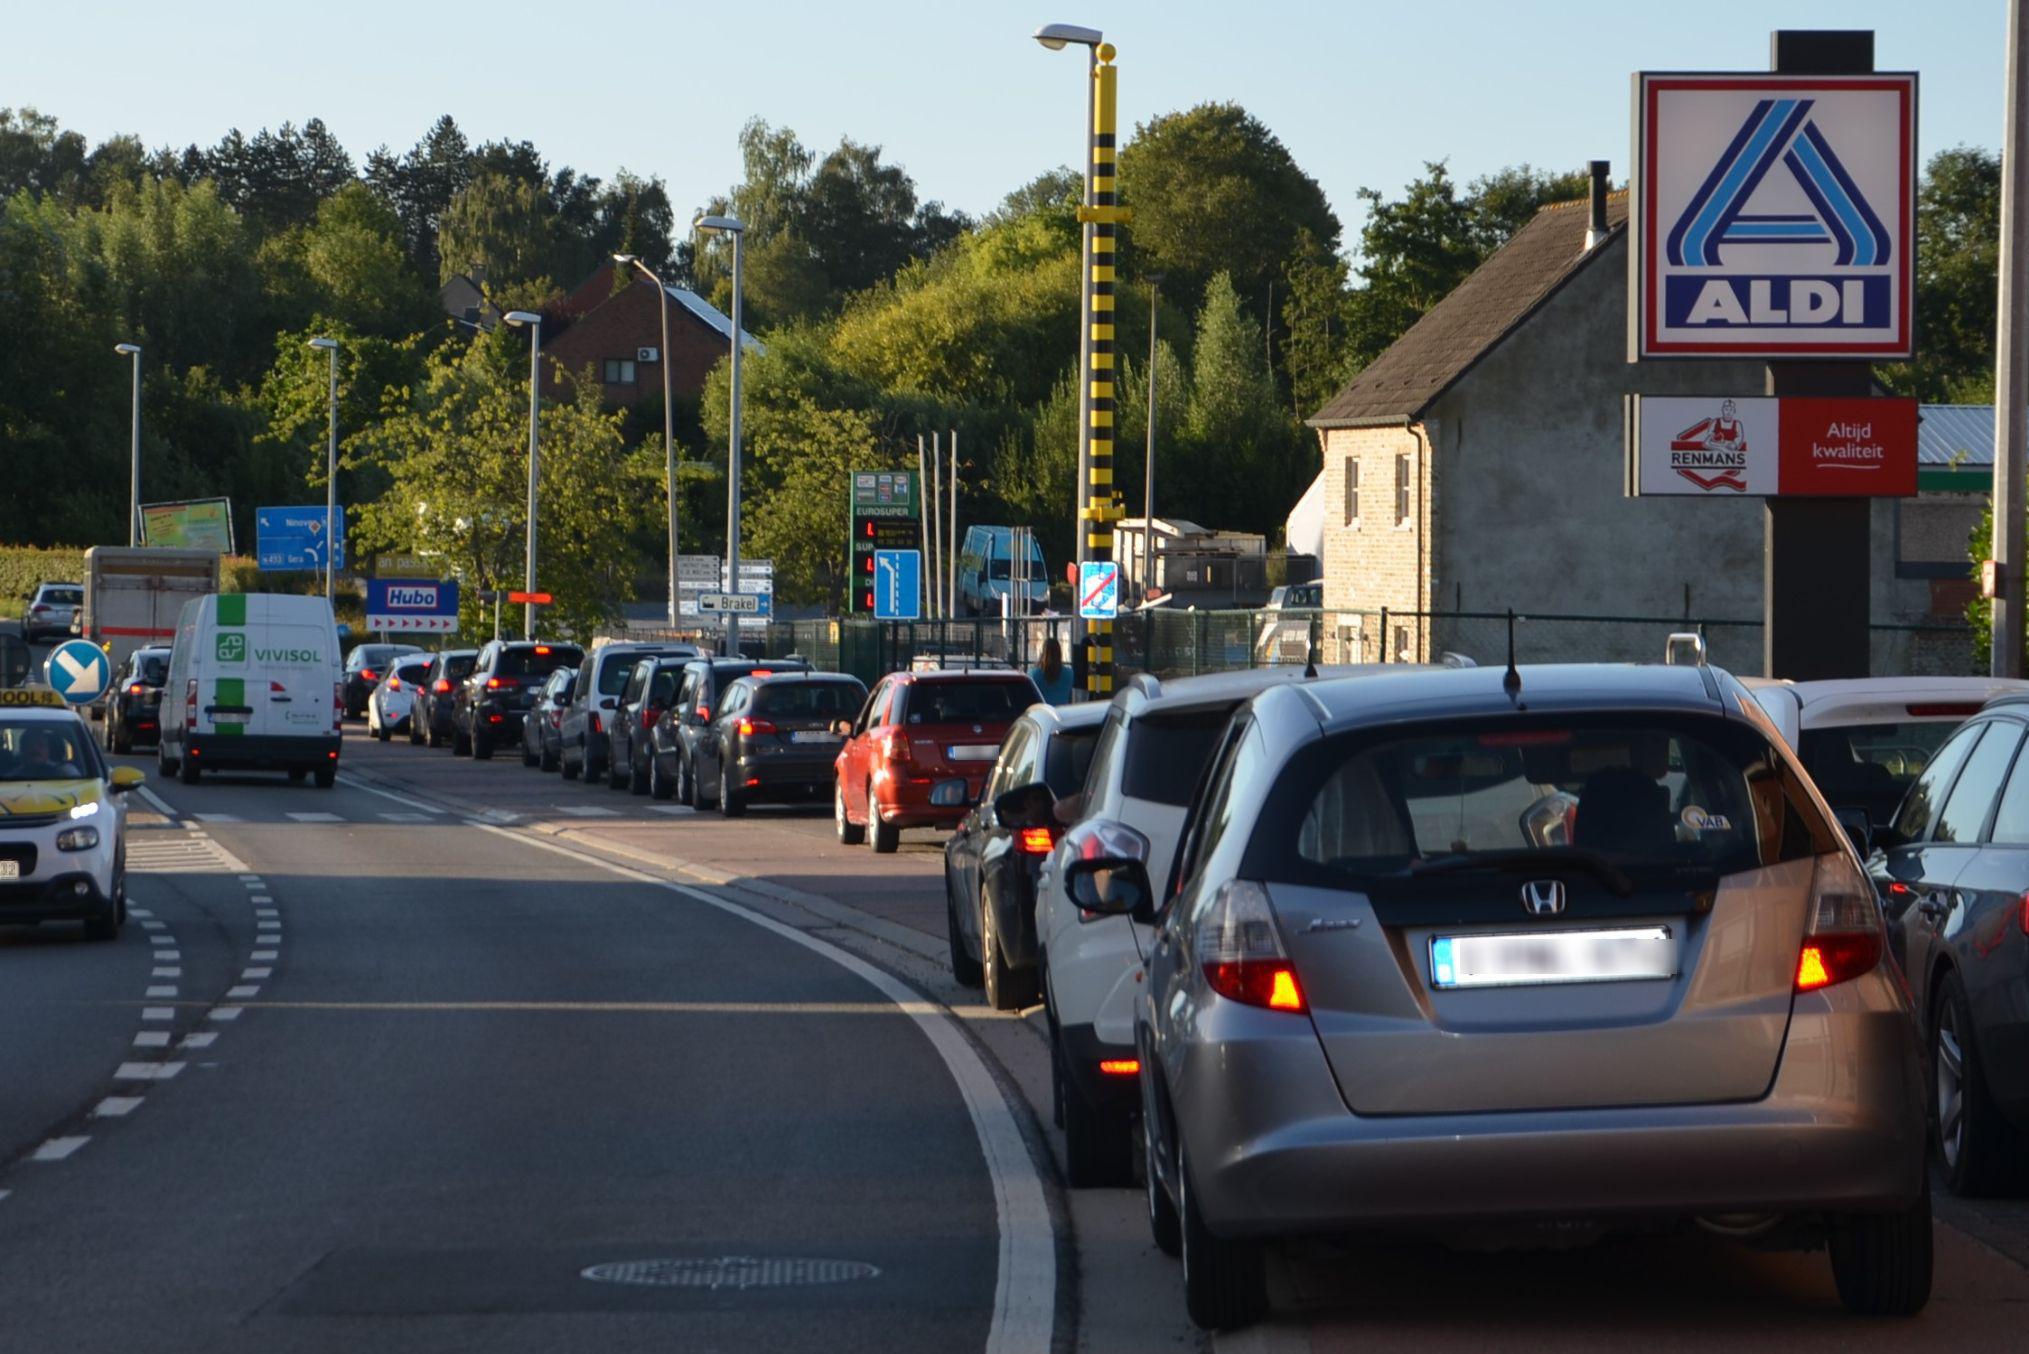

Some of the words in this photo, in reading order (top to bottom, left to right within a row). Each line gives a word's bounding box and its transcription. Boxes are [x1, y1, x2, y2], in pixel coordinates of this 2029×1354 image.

[1686, 280, 1864, 324] ALDI
[1827, 422, 1871, 442] Altijd
[1812, 442, 1884, 459] kwaliteit
[1671, 453, 1746, 465] RENMANS
[856, 507, 909, 516] EUROSUPER
[390, 590, 434, 605] Hubo
[721, 596, 756, 610] Brakel
[254, 648, 322, 662] VIVISOL
[0, 690, 38, 704] OOL
[1696, 815, 1724, 827] VAB
